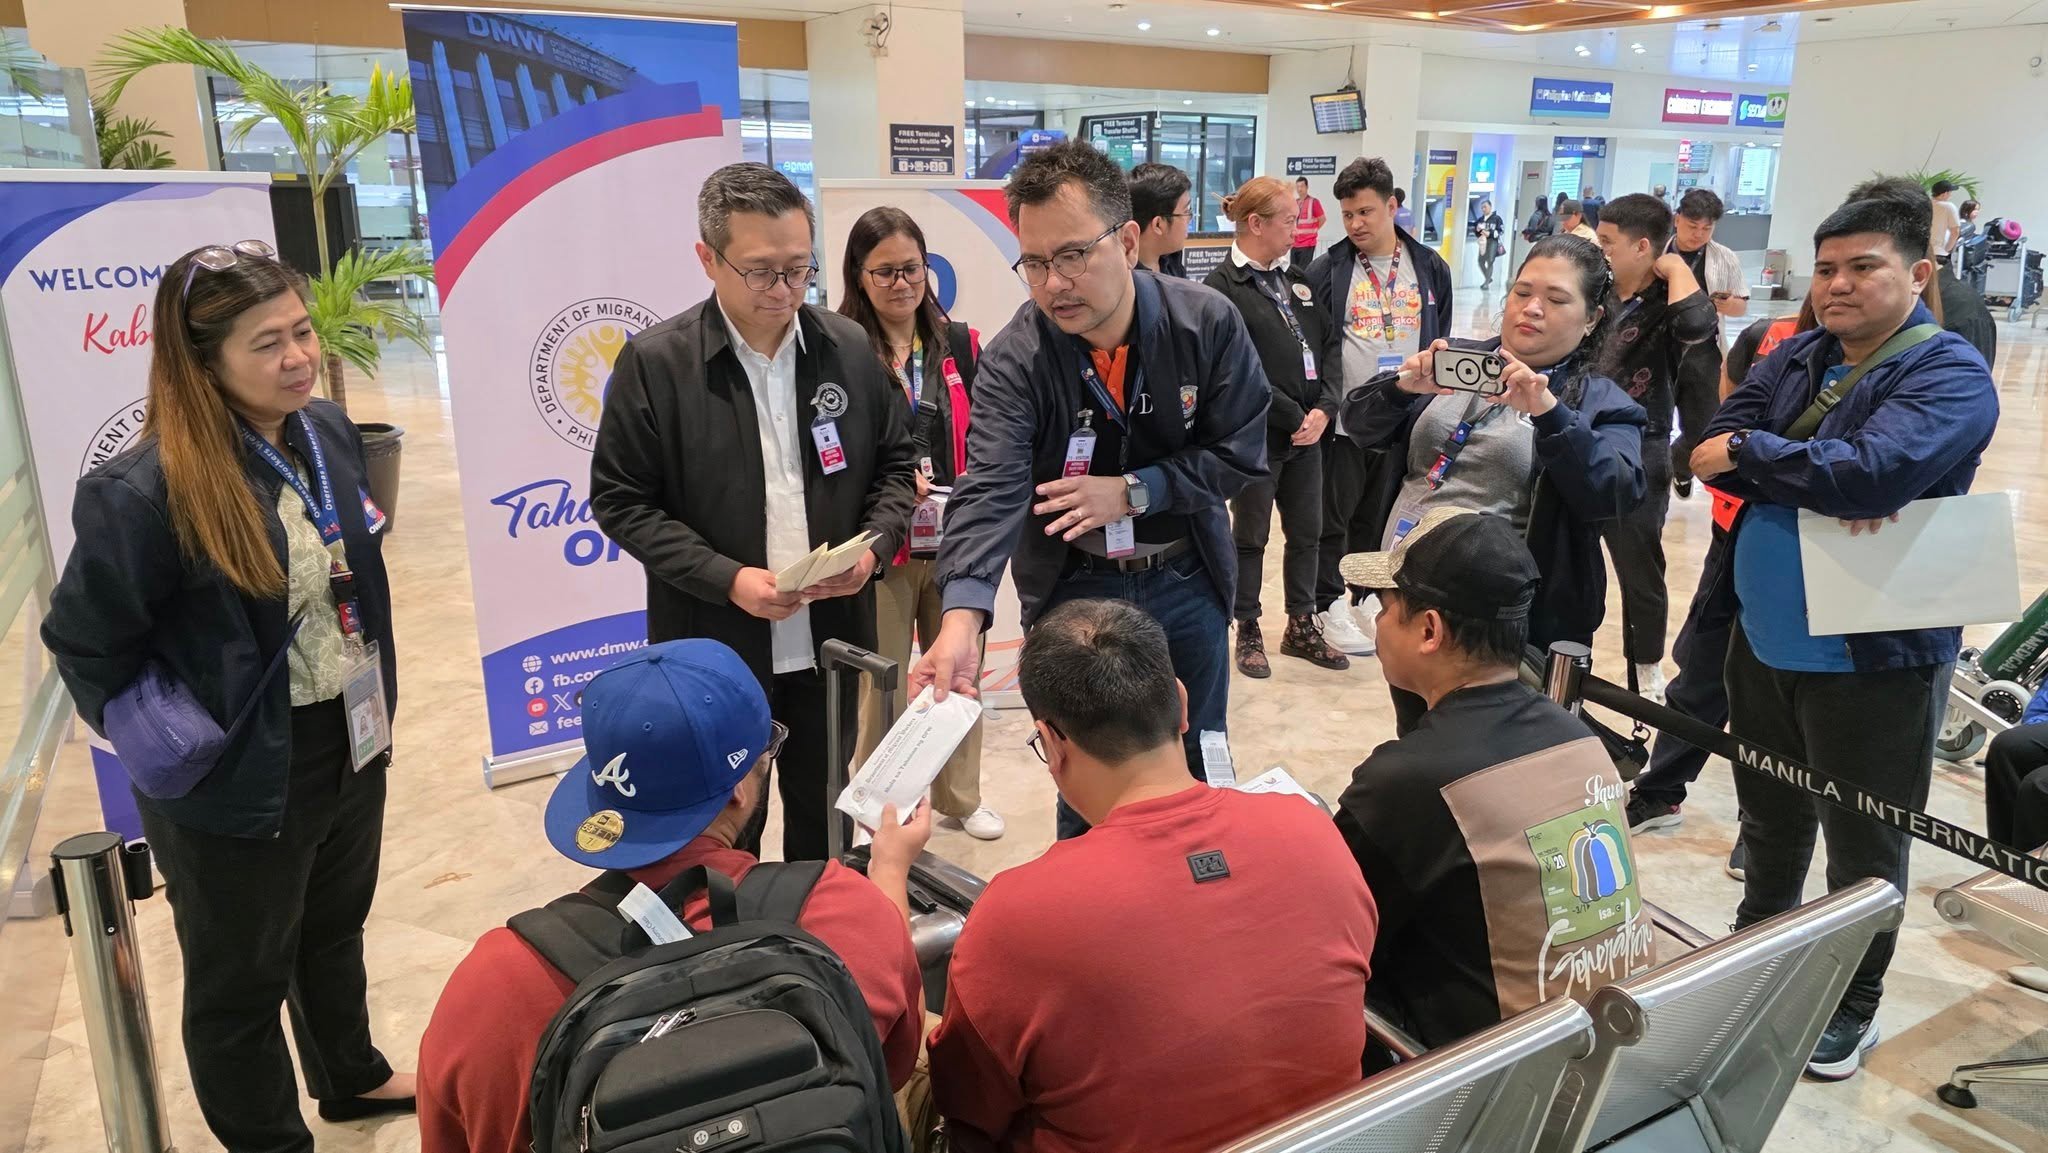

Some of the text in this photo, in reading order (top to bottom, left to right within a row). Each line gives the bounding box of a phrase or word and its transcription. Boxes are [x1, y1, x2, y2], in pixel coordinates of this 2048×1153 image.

[465, 13, 544, 55] DMW
[29, 264, 171, 292] WELCOM
[83, 303, 154, 354] Kab
[536, 303, 658, 414] DEPARTMENT OF MIGRAN
[89, 418, 130, 473] MENT
[262, 448, 295, 481] Workers
[293, 480, 321, 519] Overseas
[319, 470, 334, 511] Overseas
[557, 716, 582, 729] fee
[592, 752, 636, 797] A
[1738, 744, 1842, 802] MANILA
[1553, 854, 1566, 870] 20
